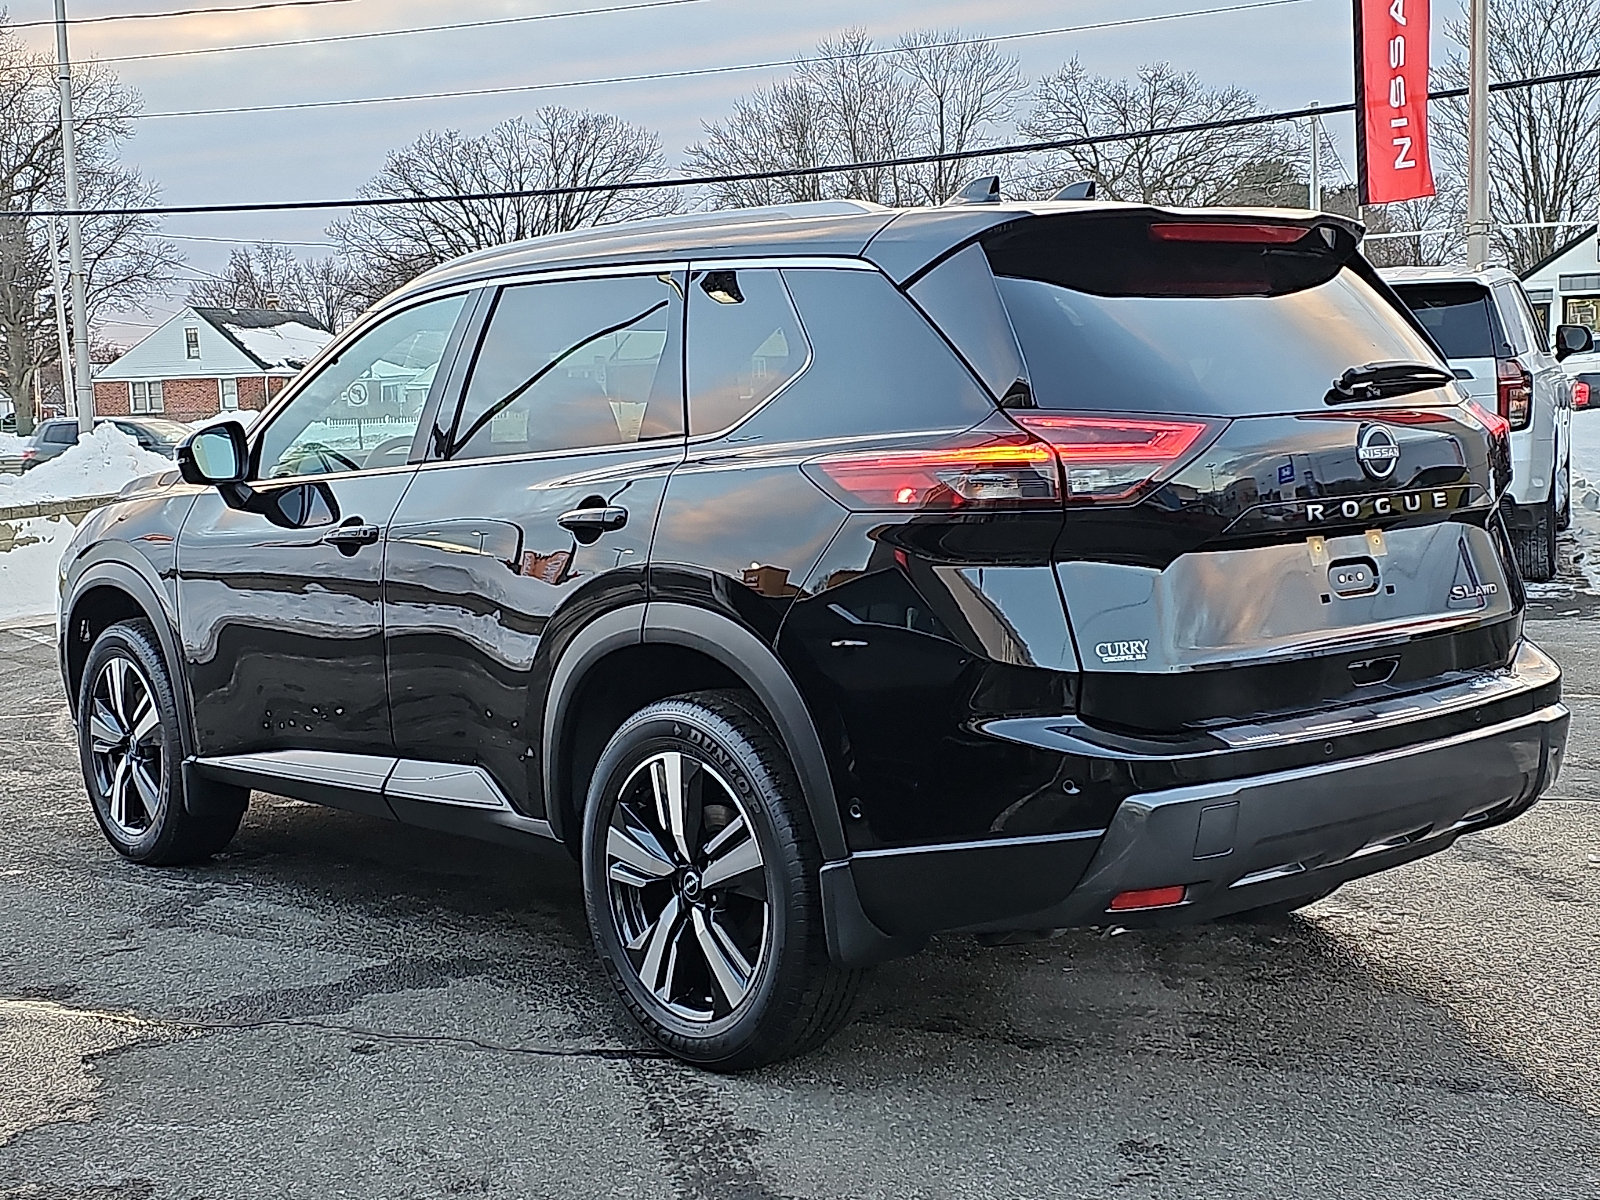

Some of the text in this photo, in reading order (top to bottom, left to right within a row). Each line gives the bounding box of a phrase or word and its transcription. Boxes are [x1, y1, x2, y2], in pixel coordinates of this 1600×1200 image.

[1360, 447, 1399, 458] NISSAN
[1307, 492, 1448, 521] ROGUE
[1451, 583, 1497, 600] SL AWD
[1095, 640, 1148, 657] CURRY
[687, 728, 760, 813] DUNLOP
